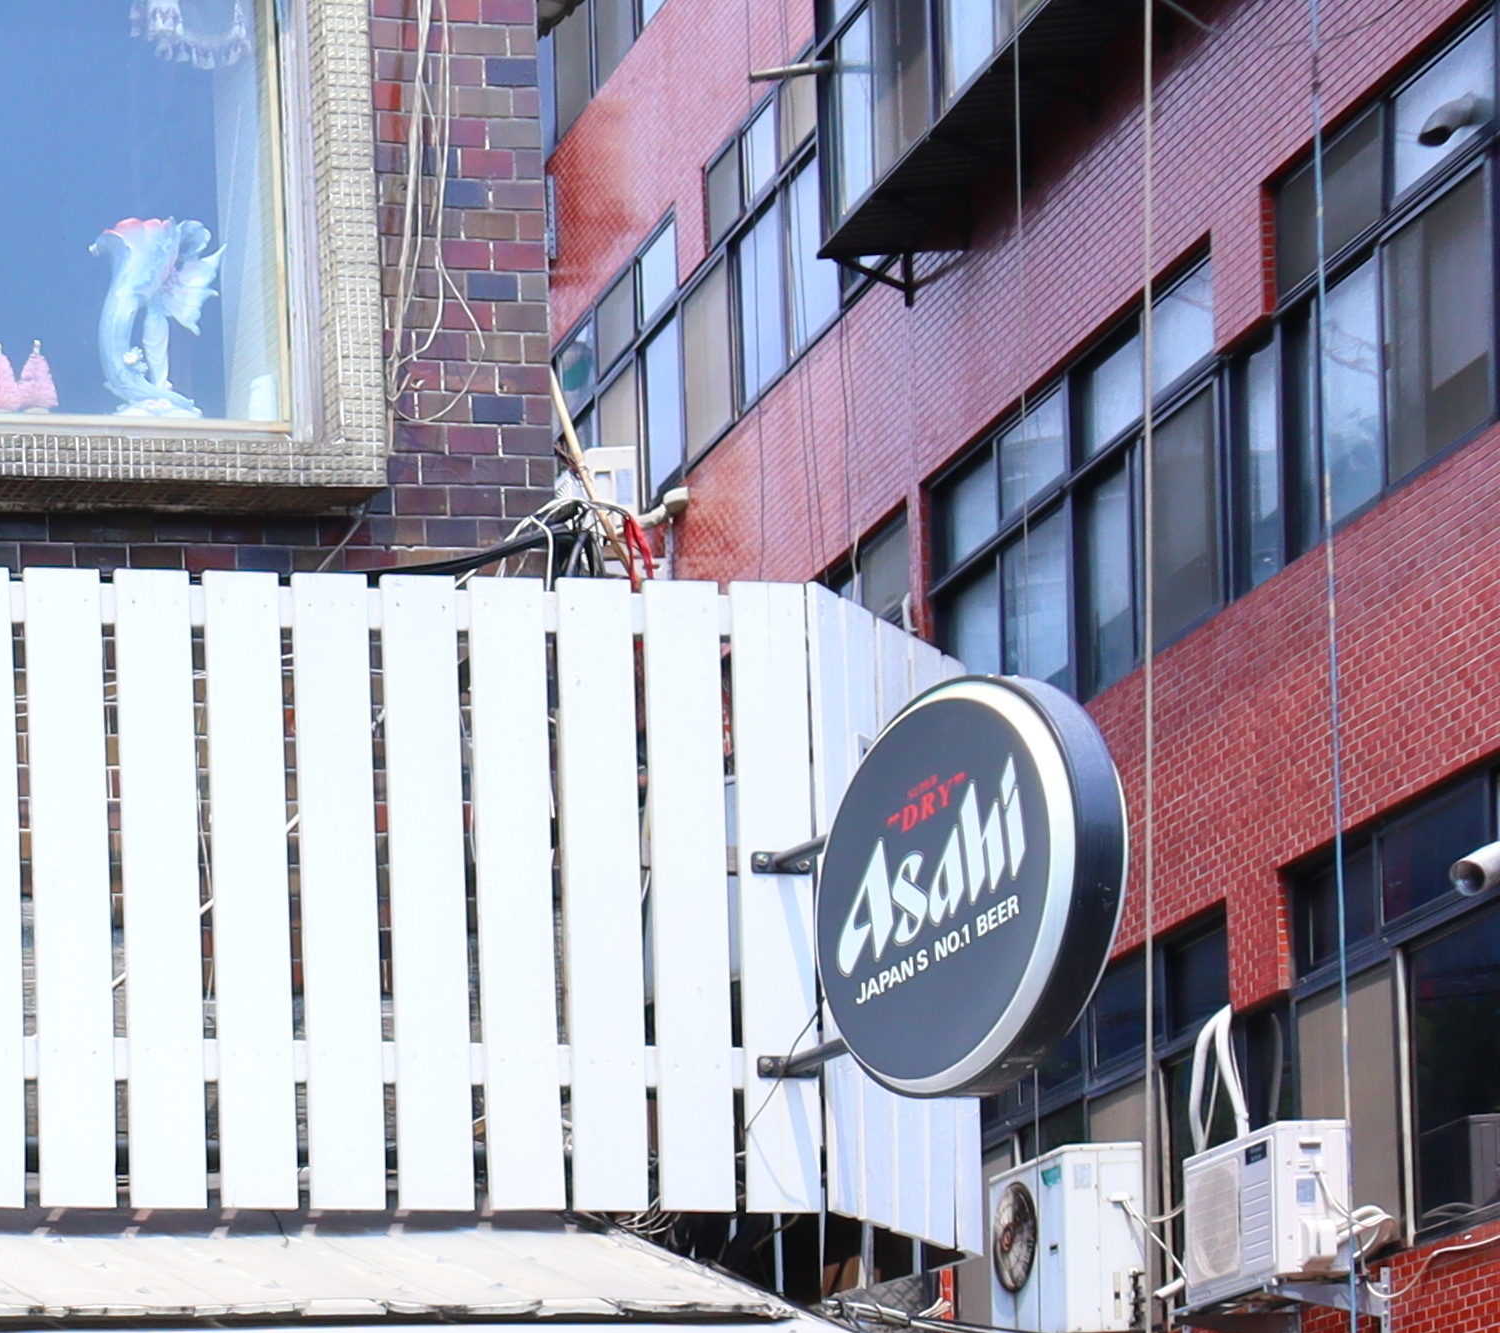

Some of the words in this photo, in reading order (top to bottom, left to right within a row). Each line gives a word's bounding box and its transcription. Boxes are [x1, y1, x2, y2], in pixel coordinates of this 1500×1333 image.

[837, 752, 1028, 977] Asahi
[934, 924, 971, 962] NO.1
[976, 895, 1020, 937] BEER
